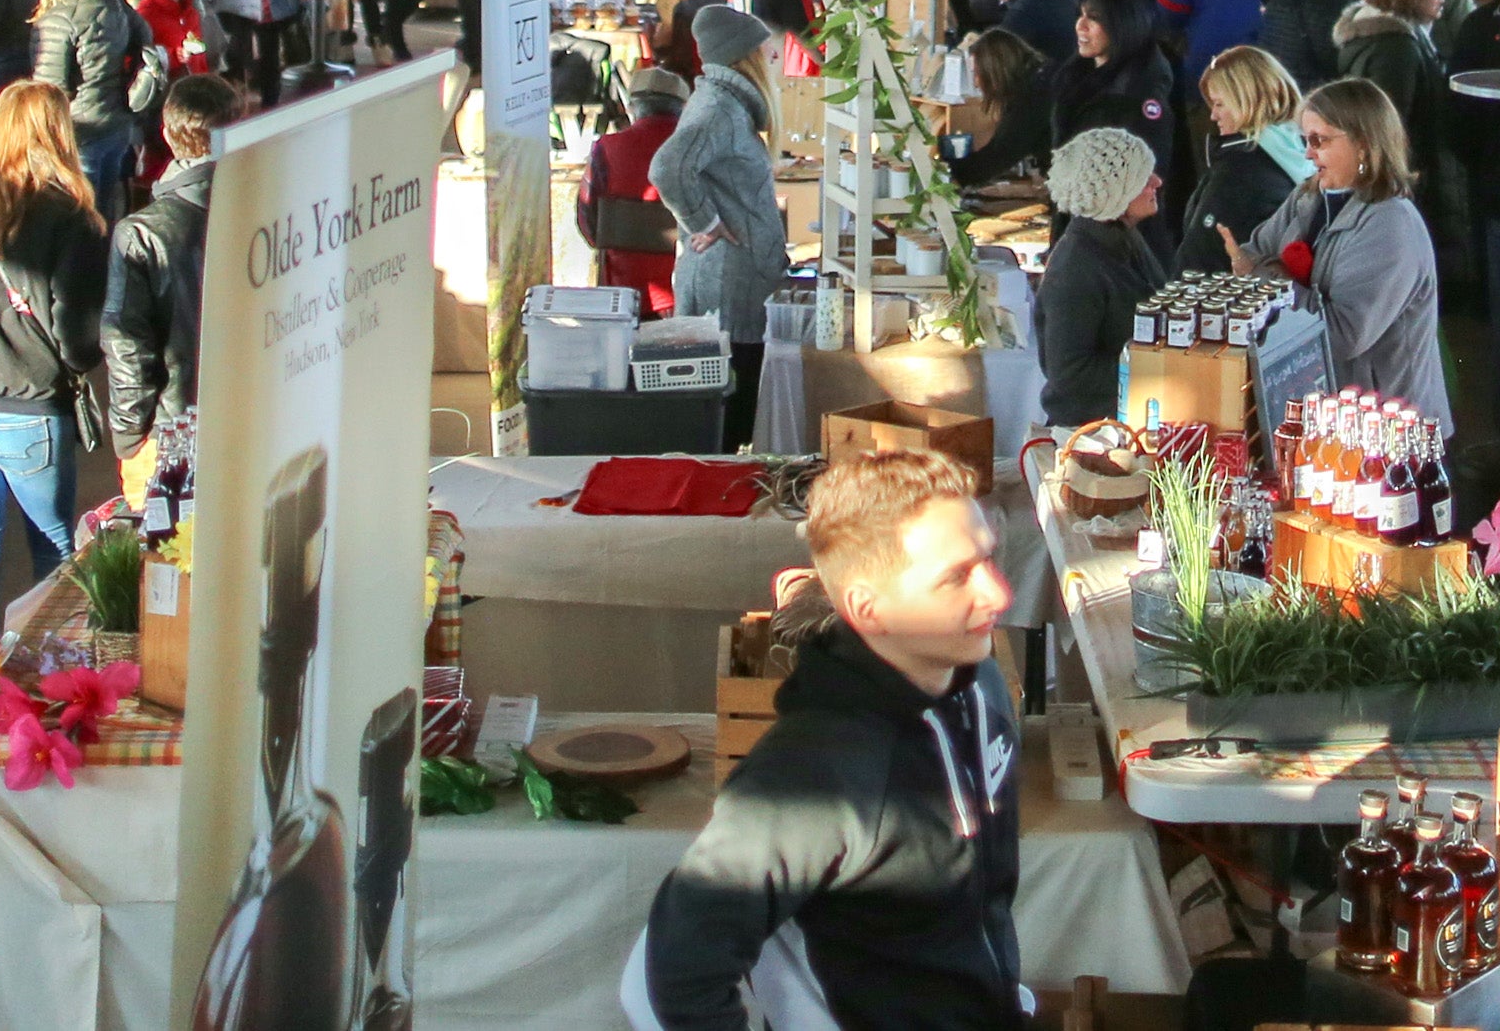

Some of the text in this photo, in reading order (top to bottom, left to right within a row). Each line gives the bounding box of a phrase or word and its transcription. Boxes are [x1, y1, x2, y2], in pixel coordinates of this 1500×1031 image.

[247, 173, 422, 290] Olde York Farm
[263, 251, 407, 350] Distillery & Cooperage
